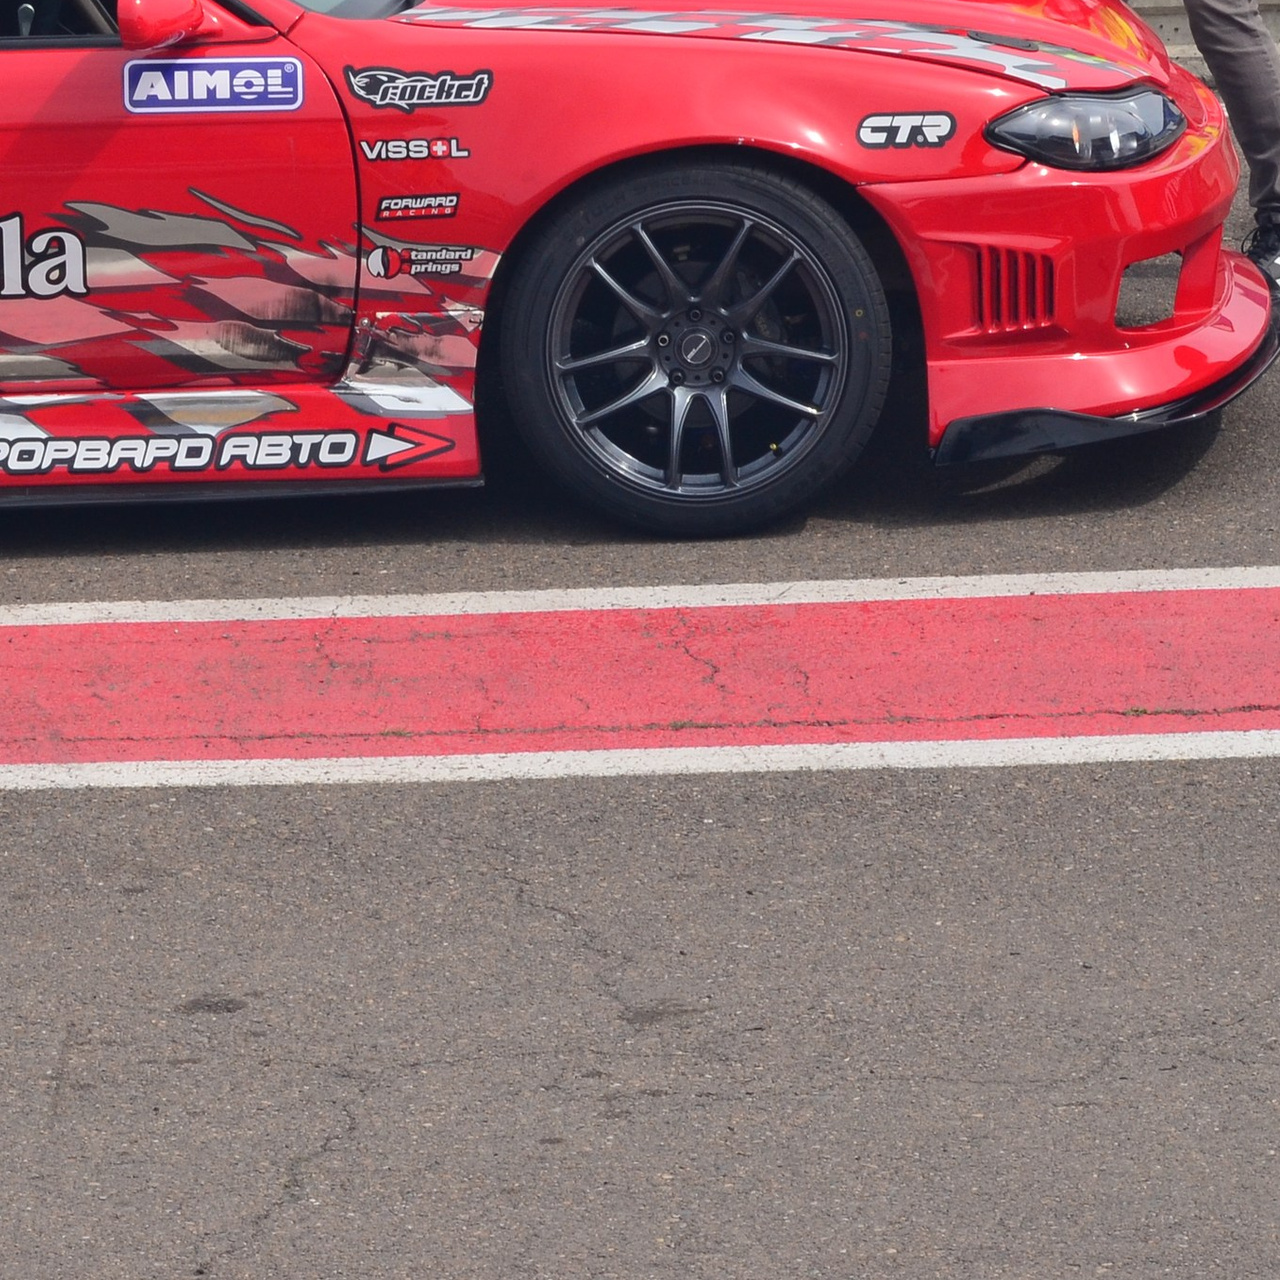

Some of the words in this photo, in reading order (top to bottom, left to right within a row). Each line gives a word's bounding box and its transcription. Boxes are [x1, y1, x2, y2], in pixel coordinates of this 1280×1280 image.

[132, 69, 295, 101] AIMOL
[860, 115, 951, 143] CTR
[380, 195, 457, 209] FORWARD
[382, 208, 452, 217] RACING
[400, 248, 471, 261] Standard
[400, 262, 460, 275] Springs
[220, 433, 357, 466] АВТО
